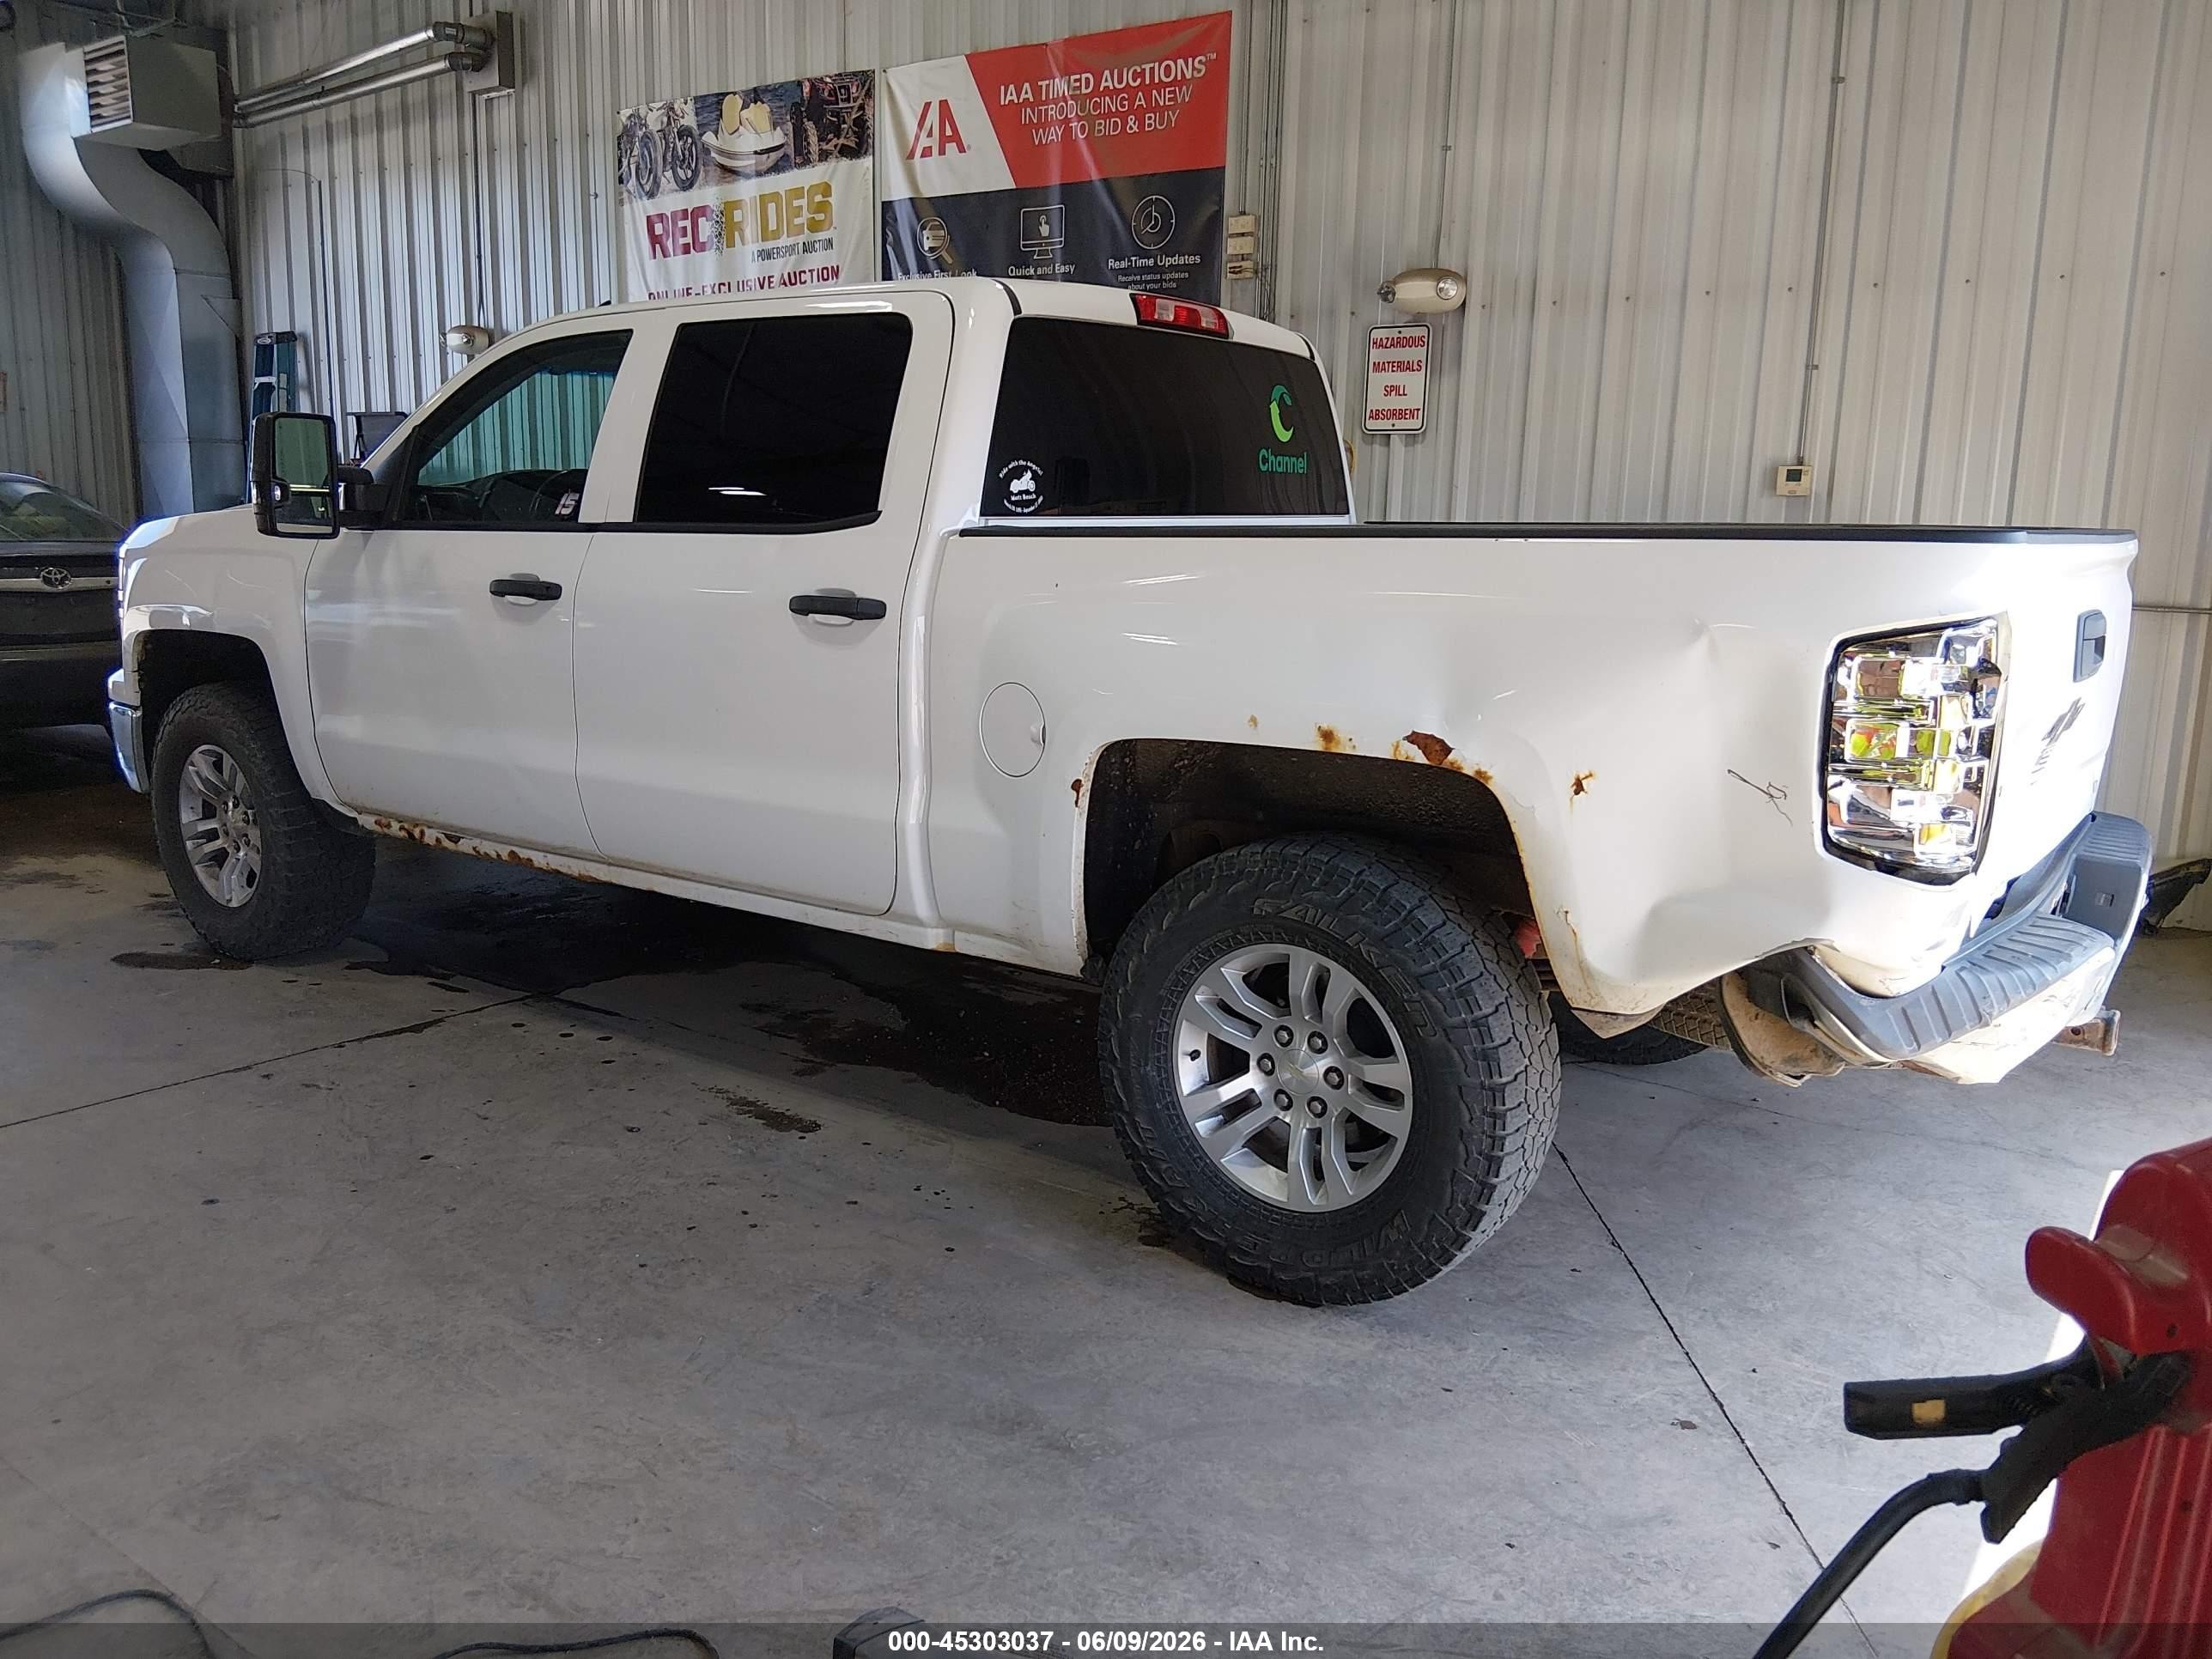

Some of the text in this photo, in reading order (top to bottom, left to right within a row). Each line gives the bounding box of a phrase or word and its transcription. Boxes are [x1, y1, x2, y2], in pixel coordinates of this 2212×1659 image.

[1000, 82, 1034, 106] IAA
[1037, 72, 1095, 99] TIMED
[1021, 84, 1194, 125] INTRODUCING A NEW
[1031, 109, 1181, 146] WAY TO BID & BUY
[723, 180, 834, 249] RIDES
[757, 241, 801, 263] POWERSPORT
[801, 236, 835, 256] AUCTION
[1007, 262, 1076, 277] Quick and Easy
[1108, 253, 1201, 270] Real-Time Updates
[778, 264, 841, 288] AUCTION
[1117, 274, 1141, 283] Receive
[1162, 270, 1189, 280] updates
[1127, 280, 1177, 291] about your bids
[1371, 335, 1426, 350] HAZARDOUS
[1372, 360, 1423, 374] MATERIALS
[1383, 384, 1408, 398] SPILL
[1368, 408, 1421, 422] ABSORBENT
[1258, 447, 1308, 475] Channel
